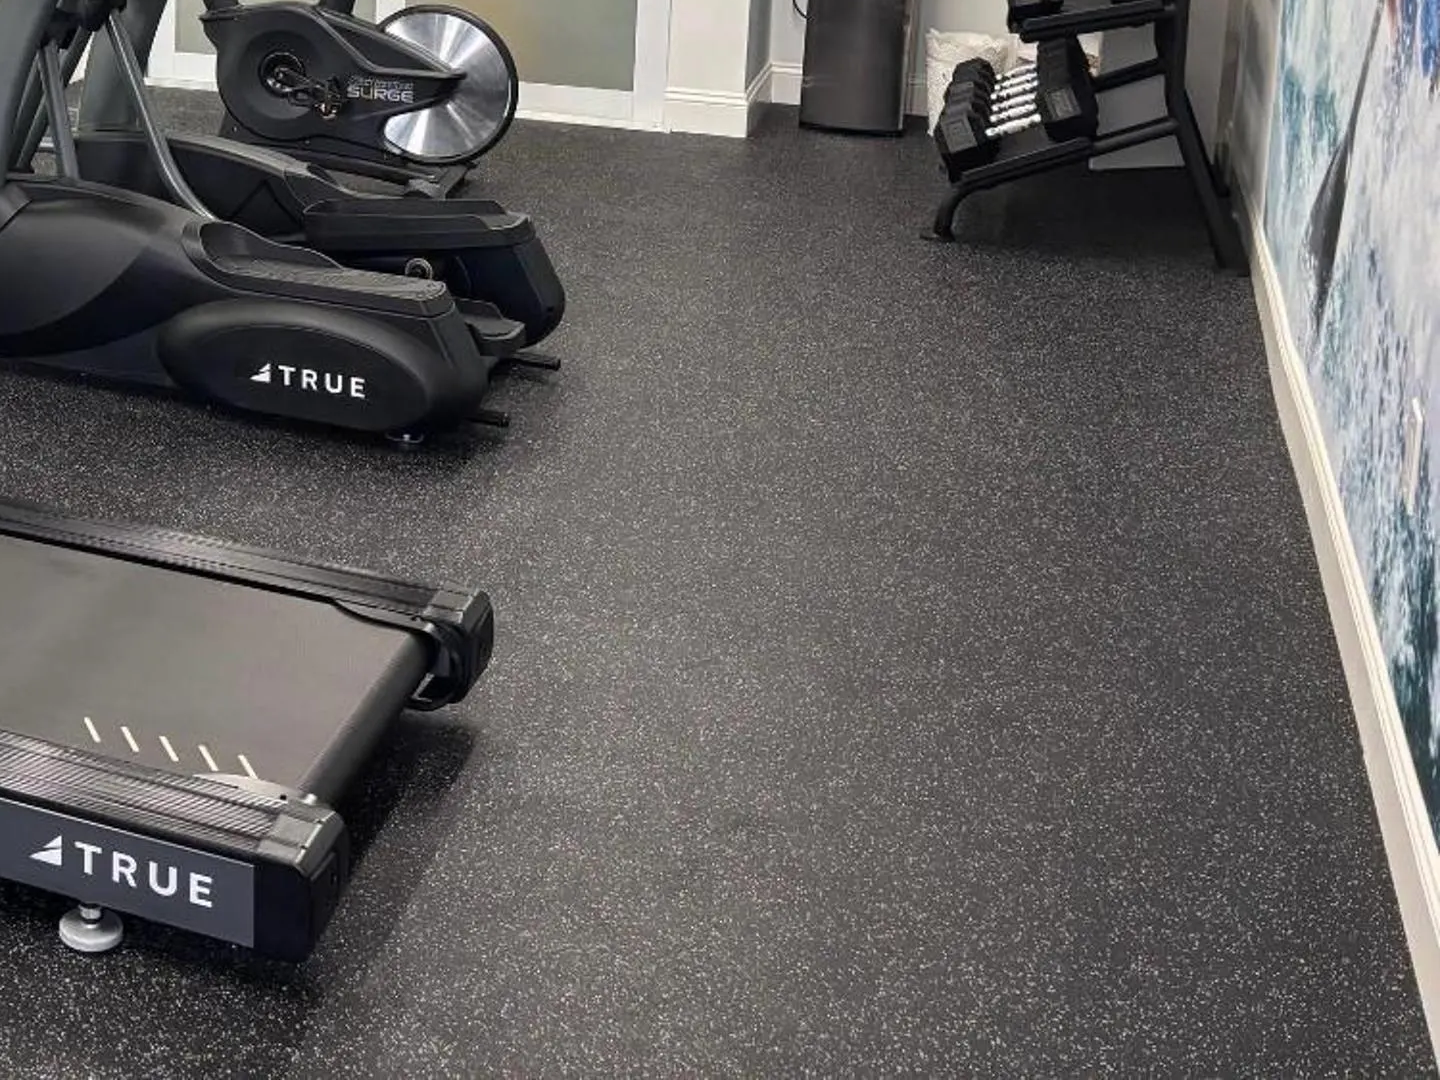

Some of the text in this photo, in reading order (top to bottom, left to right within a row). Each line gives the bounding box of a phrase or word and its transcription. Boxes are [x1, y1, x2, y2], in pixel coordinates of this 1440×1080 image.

[346, 84, 414, 104] SURGE
[277, 364, 367, 399] TRUE
[73, 841, 214, 908] TRUE
